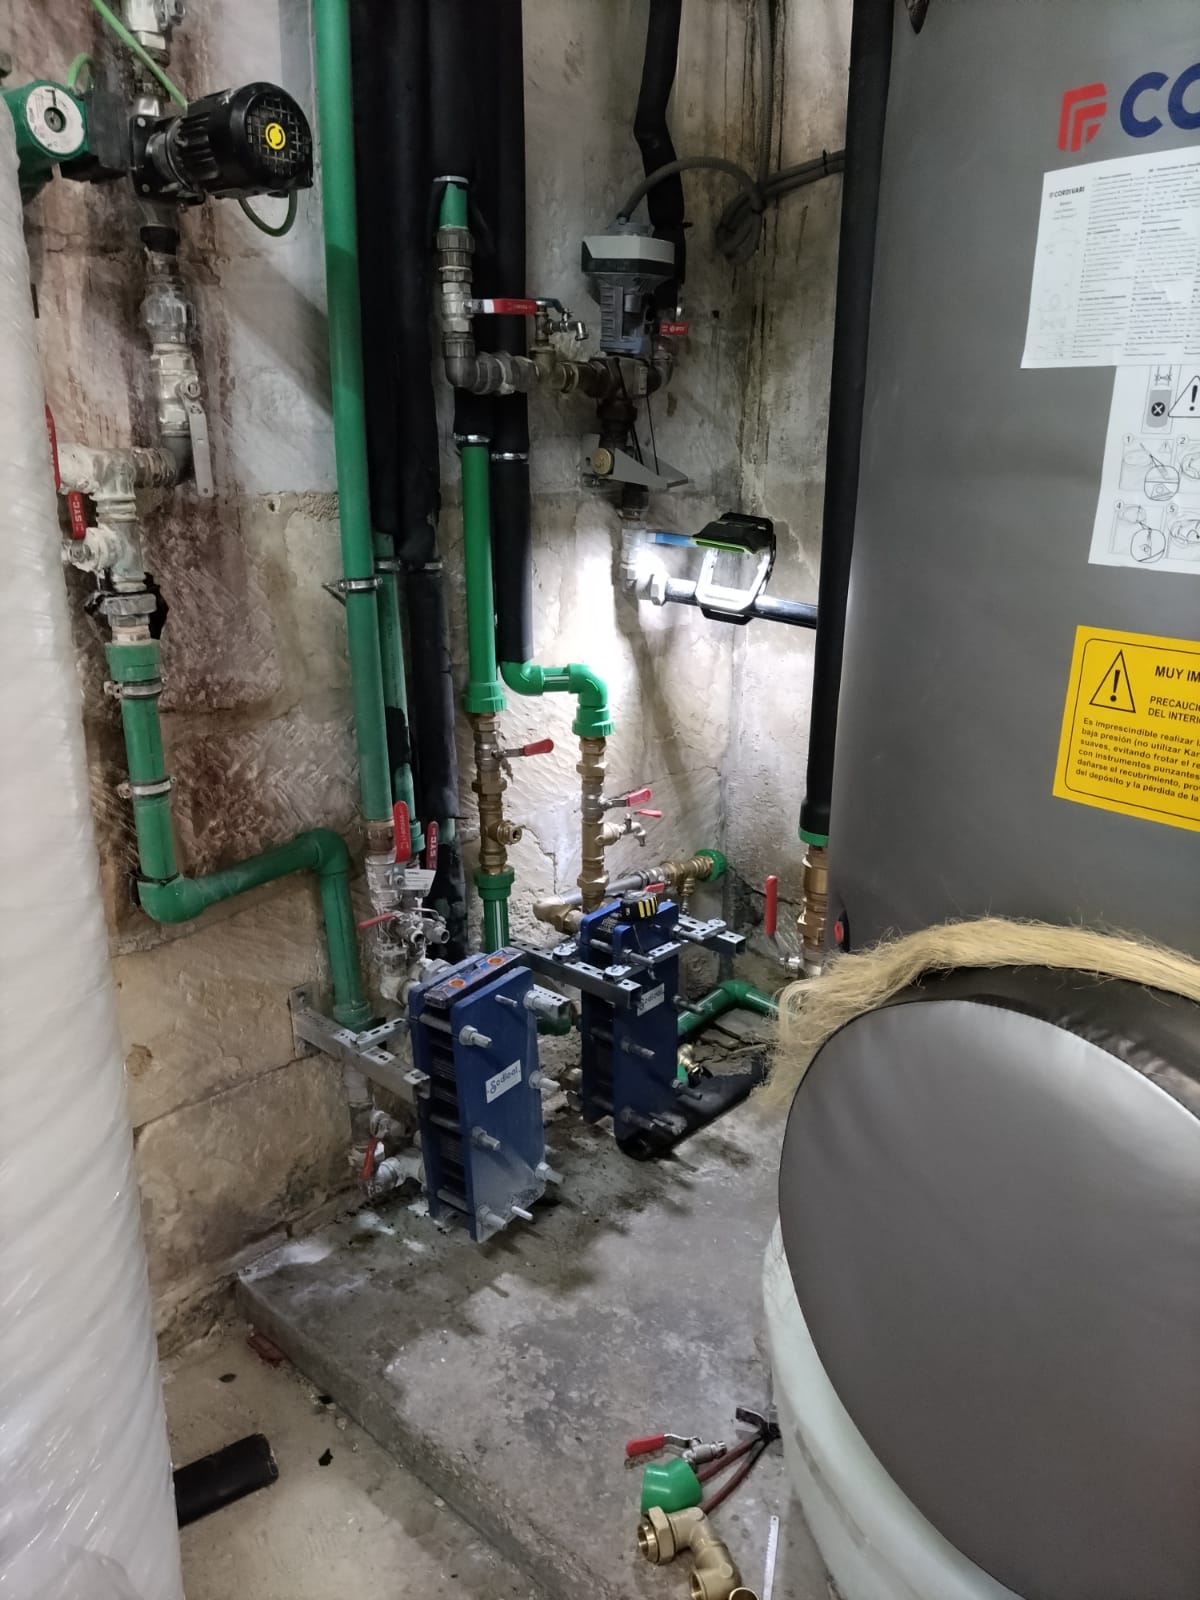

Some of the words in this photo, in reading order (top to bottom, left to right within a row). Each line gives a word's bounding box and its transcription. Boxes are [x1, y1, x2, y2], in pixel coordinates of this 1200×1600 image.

[1155, 665, 1184, 680] MUY
[1148, 707, 1166, 719] DEL
[1168, 711, 1200, 725] INTERI
[1081, 728, 1098, 738] baja
[1100, 731, 1132, 745] presión
[1134, 738, 1148, 748] (no
[1151, 743, 1182, 754] utilizar
[1083, 717, 1093, 726] Es
[1095, 720, 1158, 738] imprescindible
[1160, 734, 1194, 746] realizar
[1078, 748, 1093, 757] con
[1095, 752, 1151, 770] instrumentos
[1113, 746, 1151, 759] evitando
[1153, 753, 1178, 765] frotar
[1181, 759, 1190, 767] el
[1075, 768, 1088, 776] del
[1089, 771, 1124, 786] depósito
[1126, 780, 1132, 788] y
[1133, 779, 1141, 789] la
[1142, 784, 1175, 797] pérdida
[1177, 791, 1189, 800] de
[1191, 793, 1199, 802] la
[1077, 758, 1108, 771] dañarse
[1110, 765, 1118, 773] el
[1119, 768, 1181, 788] recubrimiento,
[1183, 784, 1200, 793] pro
